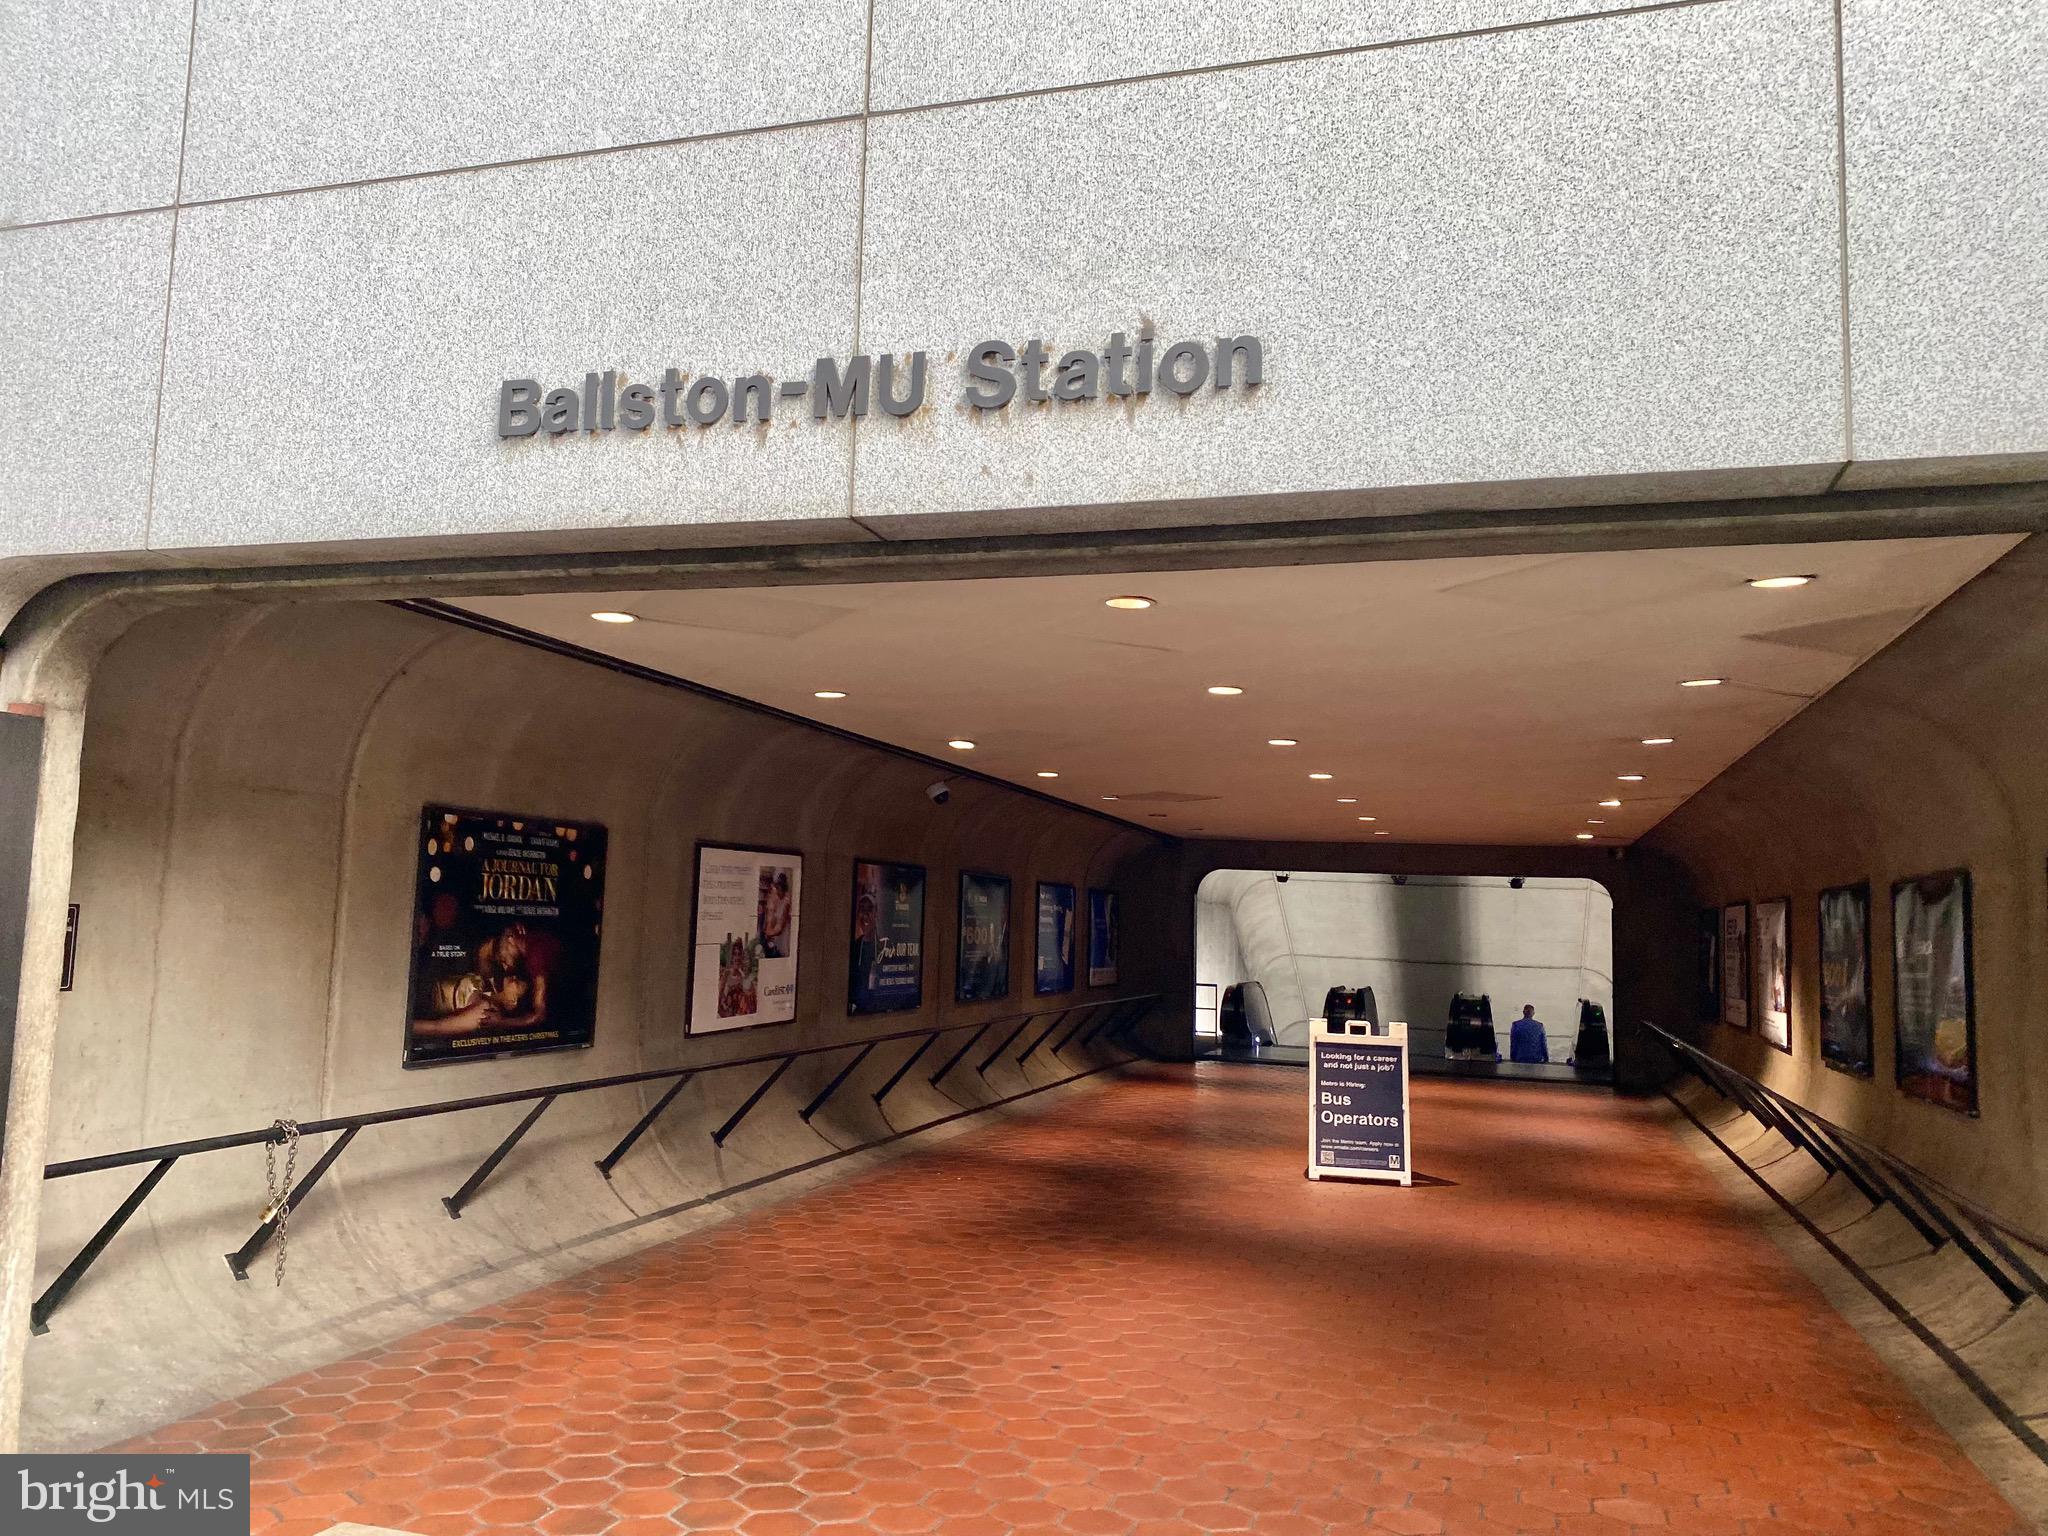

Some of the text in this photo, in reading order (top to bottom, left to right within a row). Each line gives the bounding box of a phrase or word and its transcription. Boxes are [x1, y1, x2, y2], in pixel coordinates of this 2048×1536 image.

[500, 331, 1264, 438] Ballston-MU Station
[479, 873, 557, 902] JORDAN
[452, 1037, 491, 1048] EXCLUSIVELY
[1320, 1052, 1352, 1062] Looking
[1353, 1053, 1365, 1061] for
[1373, 1055, 1398, 1063] career
[1354, 1063, 1369, 1071] just
[1377, 1064, 1395, 1072] job?
[1321, 1092, 1352, 1106] Bus
[1320, 1110, 1399, 1128] Operators
